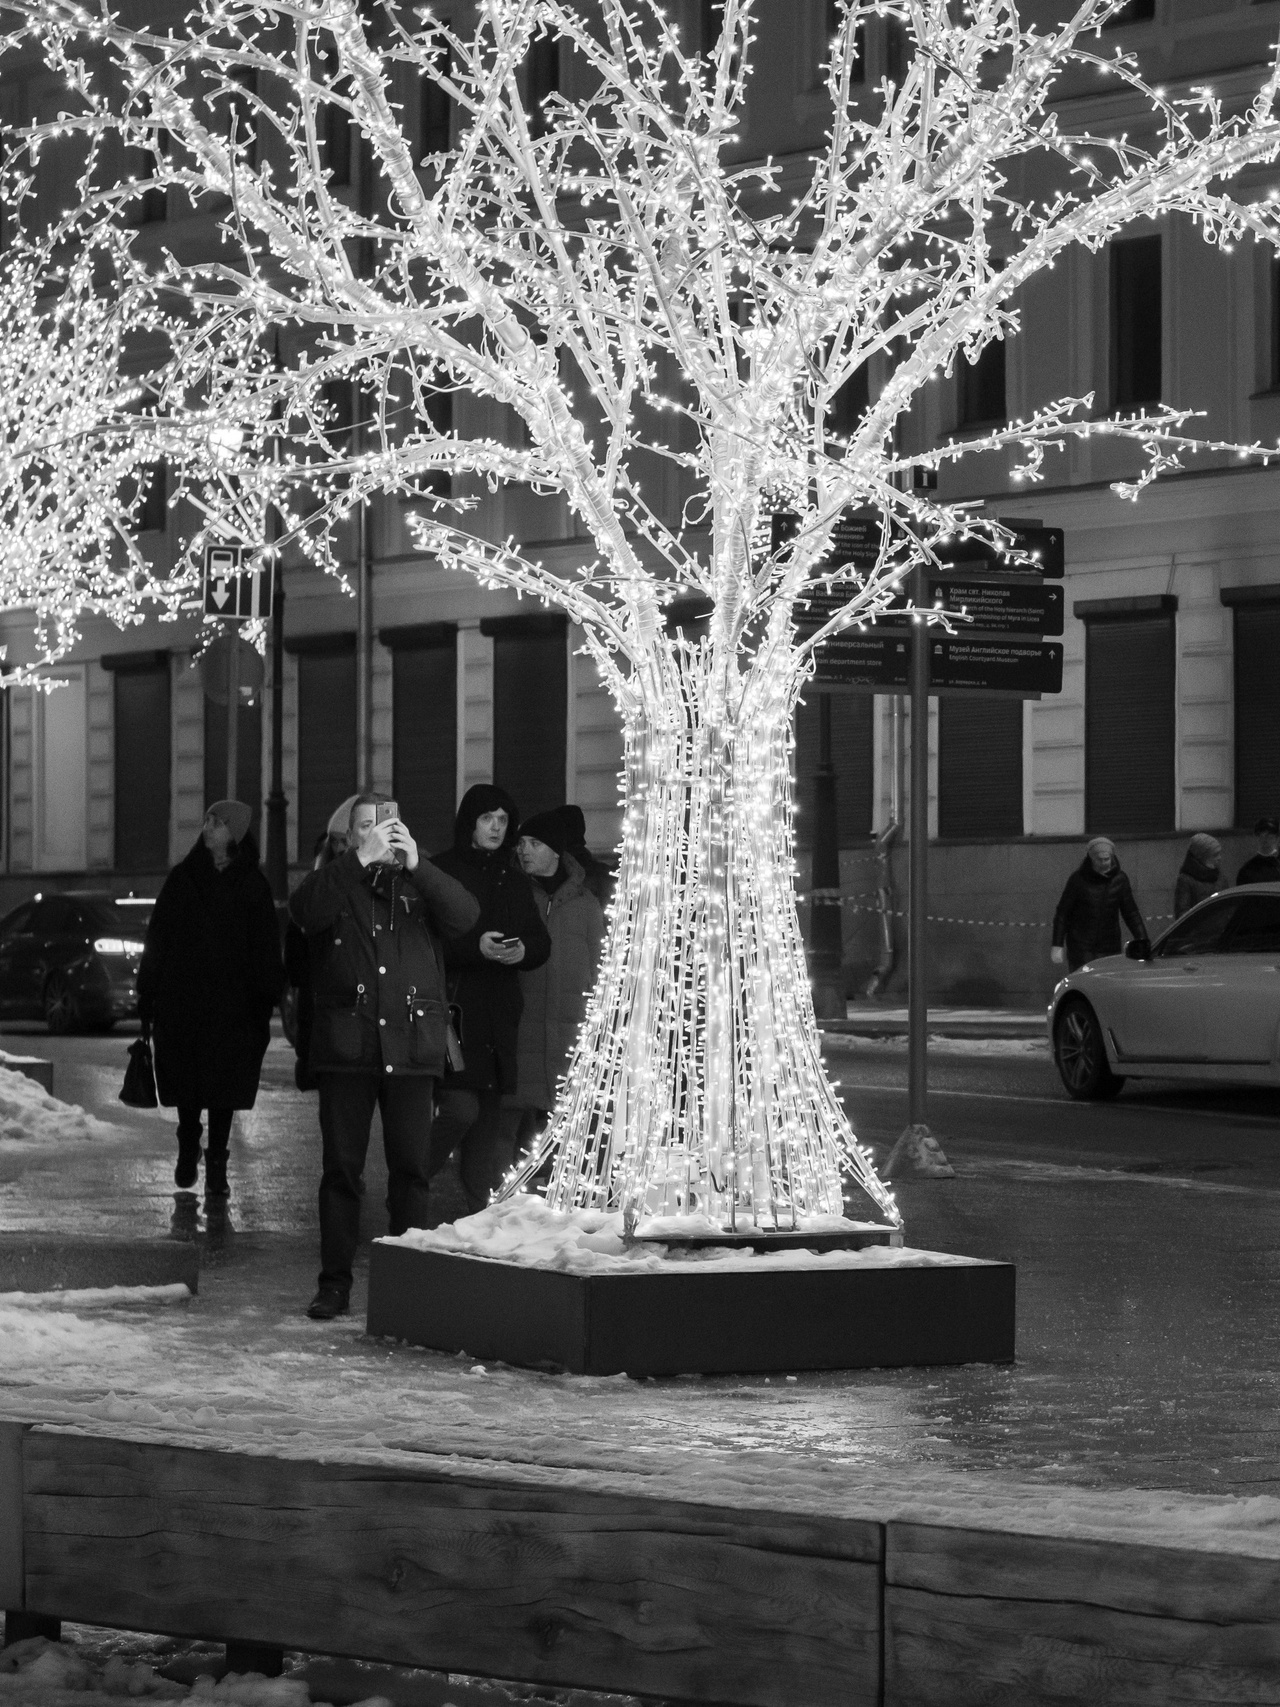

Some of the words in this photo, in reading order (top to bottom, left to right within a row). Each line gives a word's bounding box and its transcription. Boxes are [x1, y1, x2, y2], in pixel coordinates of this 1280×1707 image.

[853, 550, 864, 559] Holy
[865, 551, 878, 560] Sign
[949, 587, 967, 596] Храм
[981, 589, 1010, 597] Николая
[949, 595, 1003, 604] Мирликийского
[994, 606, 1006, 614] Holy
[1008, 615, 1020, 623] Myra
[826, 640, 884, 649] универсальный
[949, 645, 970, 654] Музей
[971, 646, 1009, 655] Английское
[1011, 648, 1042, 657] подворье
[829, 657, 866, 666] department
[949, 654, 968, 662] English
[969, 655, 995, 663] Courtyard
